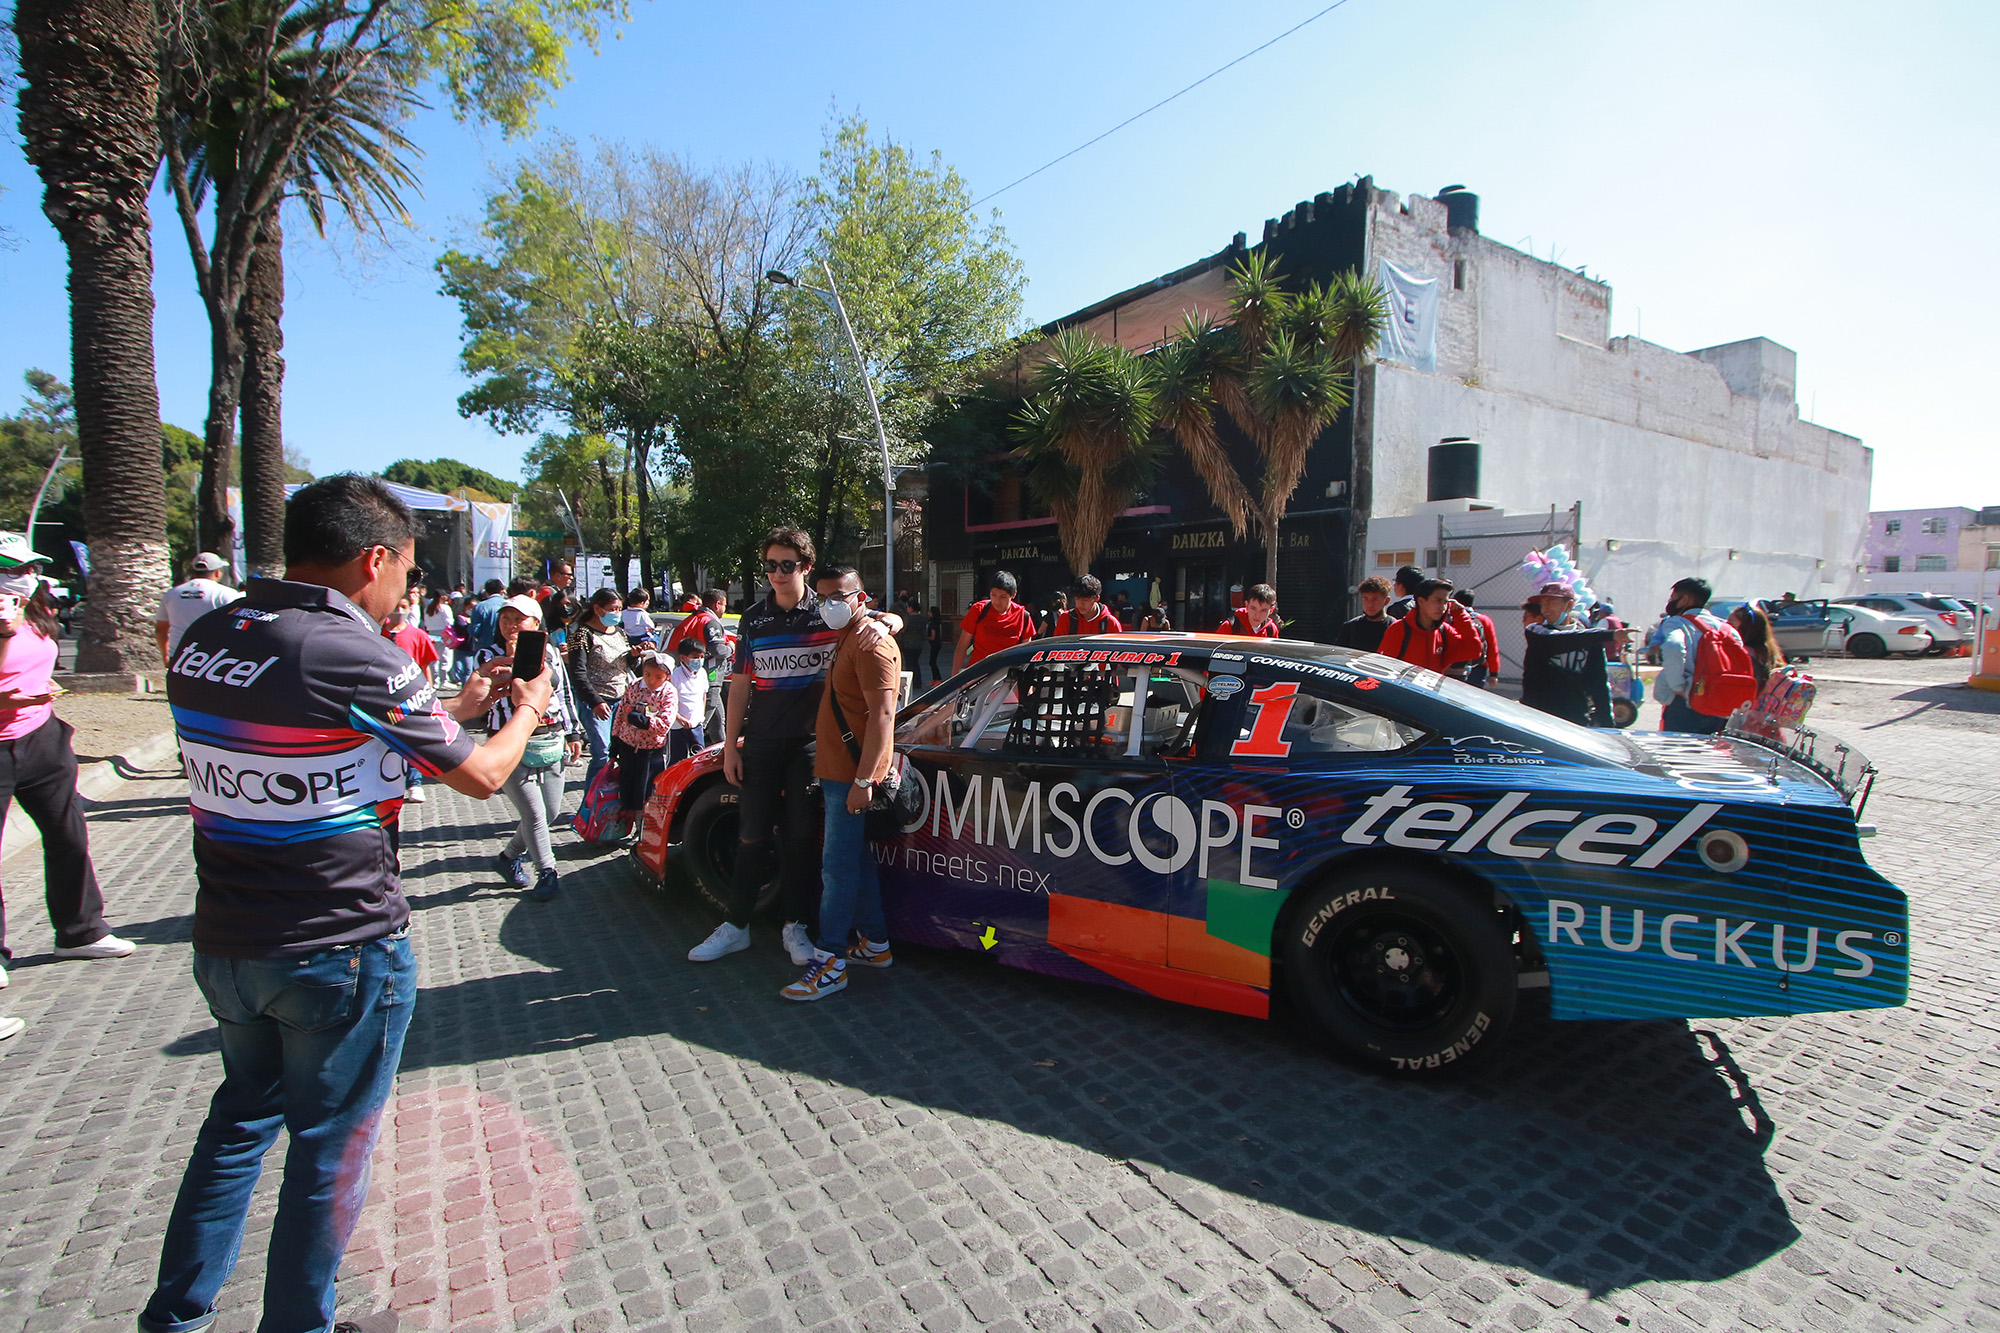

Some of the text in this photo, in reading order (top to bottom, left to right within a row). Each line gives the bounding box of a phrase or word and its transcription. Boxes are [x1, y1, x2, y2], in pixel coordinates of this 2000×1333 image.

[1172, 531, 1225, 550] DANZKA
[1001, 546, 1039, 560] DANZKA
[236, 607, 280, 623] NASCAR
[172, 642, 279, 688] telcel
[754, 650, 838, 671] OMMSCOP
[1088, 651, 1111, 662] DE
[1109, 651, 1147, 663] LARA
[1164, 651, 1183, 666] 1
[1250, 656, 1360, 684] GOKARTMANIA
[1105, 714, 1117, 727] 1
[1229, 682, 1301, 758] 1
[1487, 753, 1546, 765] Position
[1341, 784, 1724, 869] telcel
[905, 845, 988, 884] meets
[1301, 886, 1396, 948] GENERAL
[1390, 1011, 1491, 1071] GENERAL
